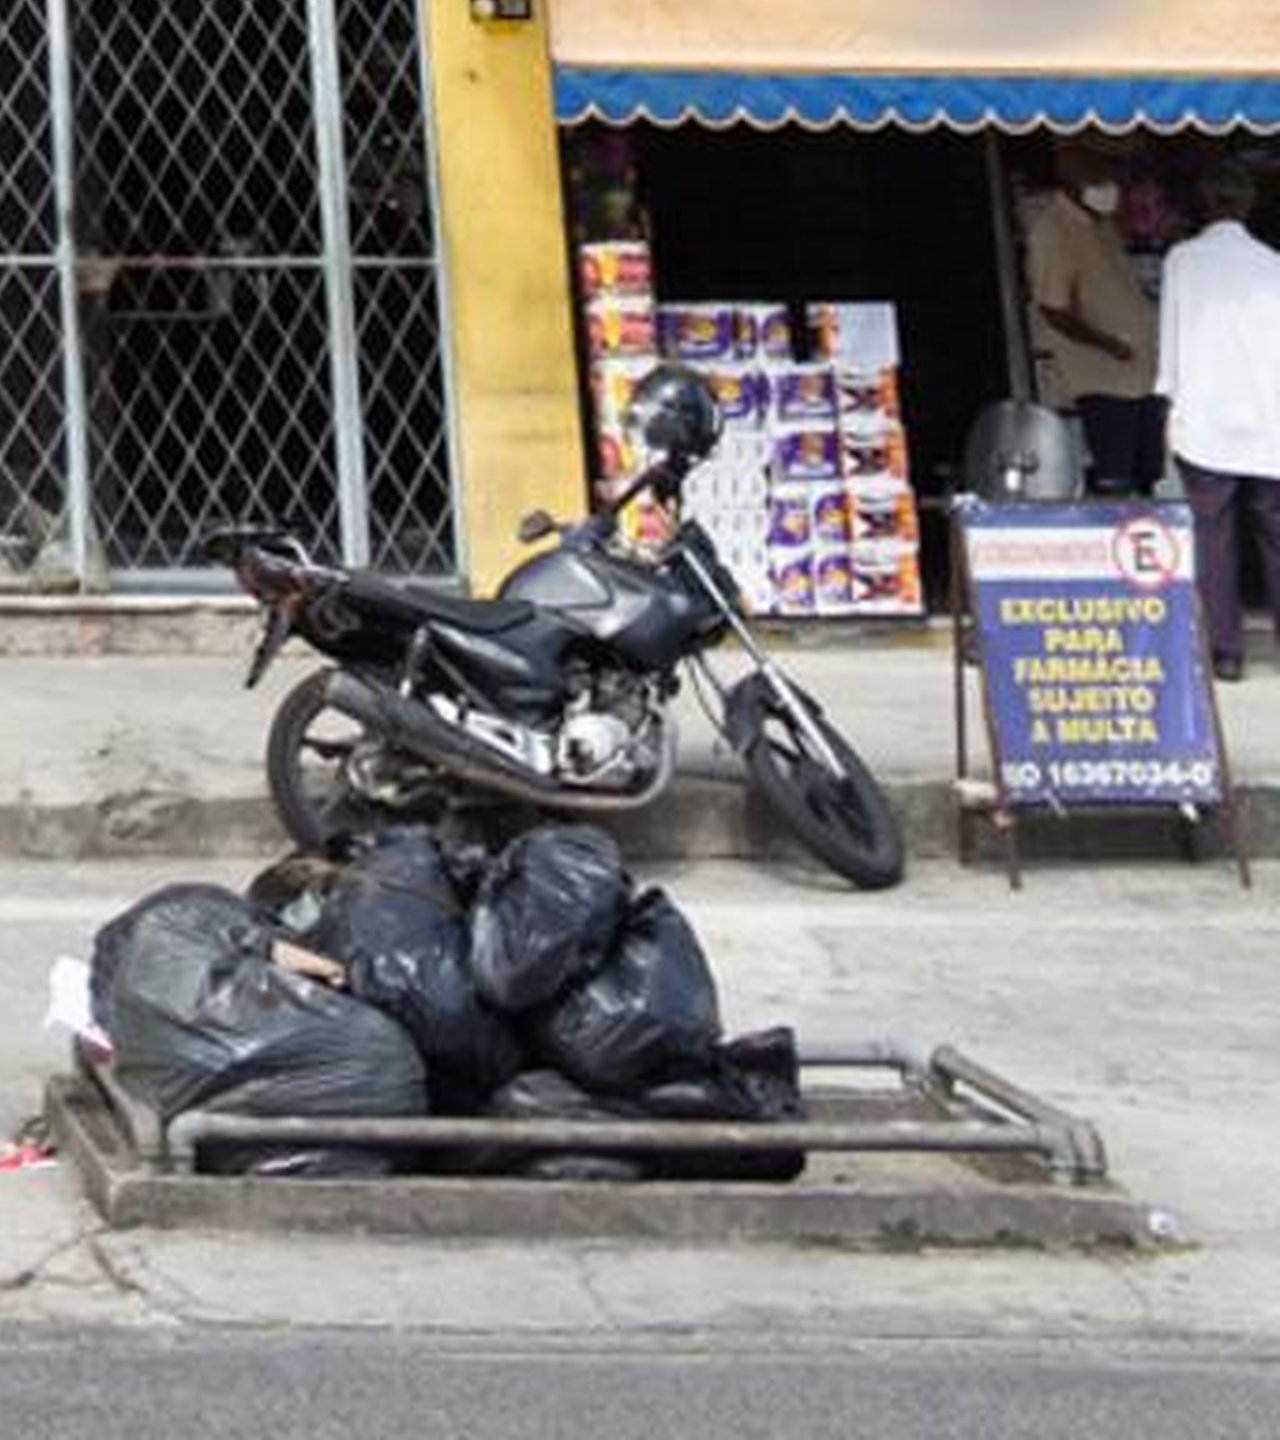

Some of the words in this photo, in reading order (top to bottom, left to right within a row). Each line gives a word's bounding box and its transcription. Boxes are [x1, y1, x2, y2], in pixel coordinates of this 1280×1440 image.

[1000, 598, 1166, 624] EXCLUSIVO
[1044, 629, 1124, 654] PARA
[1028, 686, 1156, 713] SUJEITO
[1031, 718, 1052, 744] A
[1058, 718, 1159, 744] MULTA
